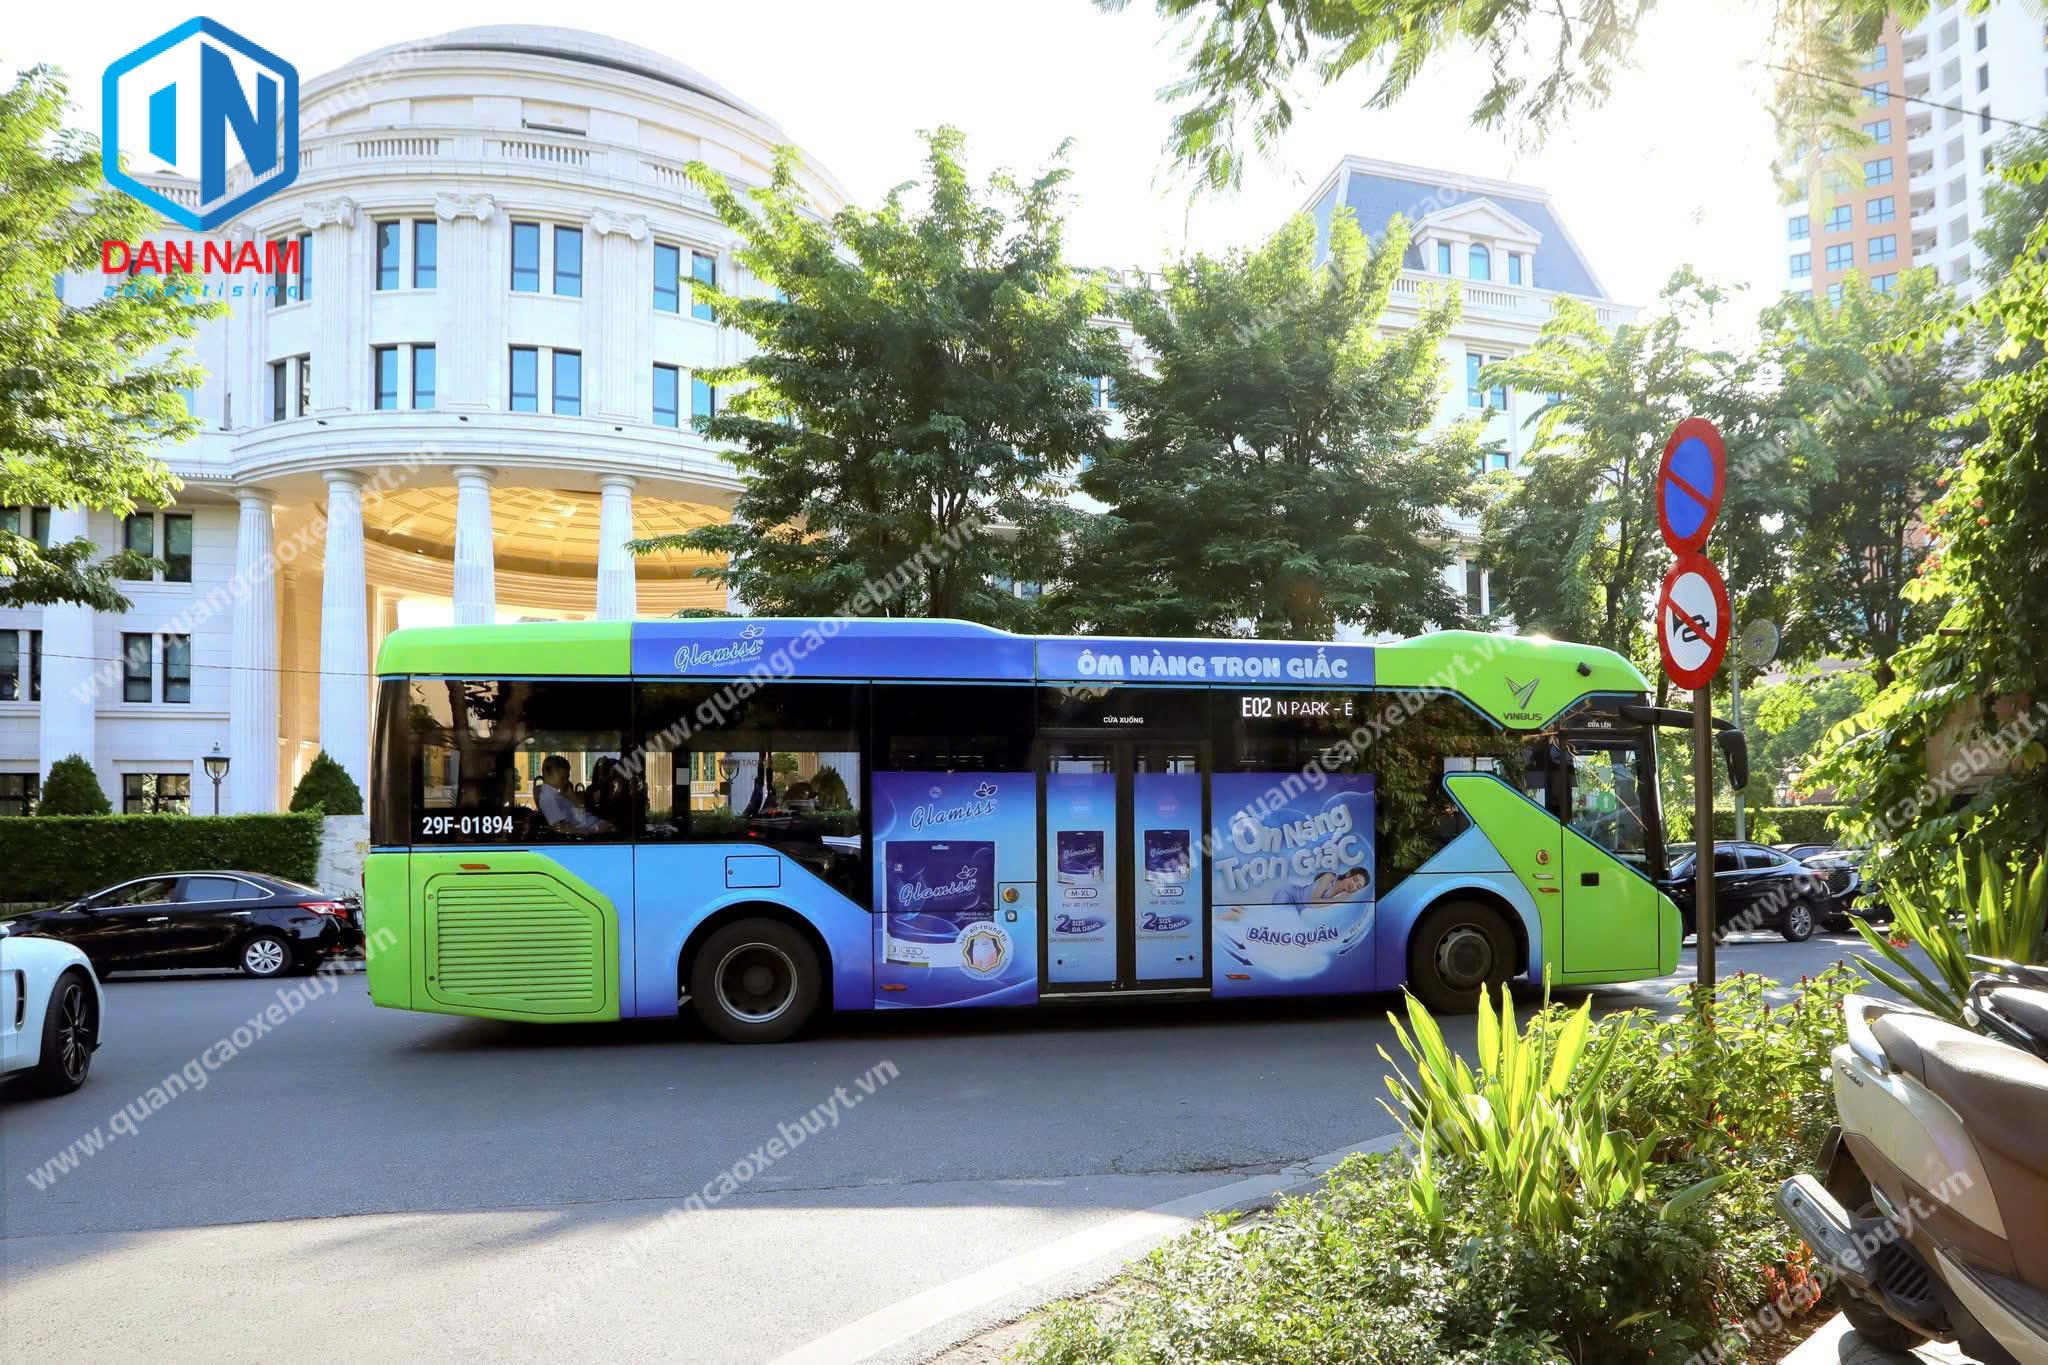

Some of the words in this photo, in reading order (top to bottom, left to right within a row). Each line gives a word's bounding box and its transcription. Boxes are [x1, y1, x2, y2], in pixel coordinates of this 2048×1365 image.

[674, 640, 763, 672] Glamiss
[1077, 649, 1124, 676] ÔM
[1131, 649, 1206, 678] NÀNG
[1211, 656, 1281, 683] TRỌN
[1287, 647, 1348, 679] GIẤC
[1242, 697, 1272, 717] E02
[1291, 701, 1329, 716] PARK
[1503, 712, 1542, 720] VINBUS
[422, 815, 513, 834] 29F-01894
[910, 798, 997, 832] Glamiss
[1247, 926, 1292, 944] BĂNG
[1294, 923, 1339, 947] QUẦN
